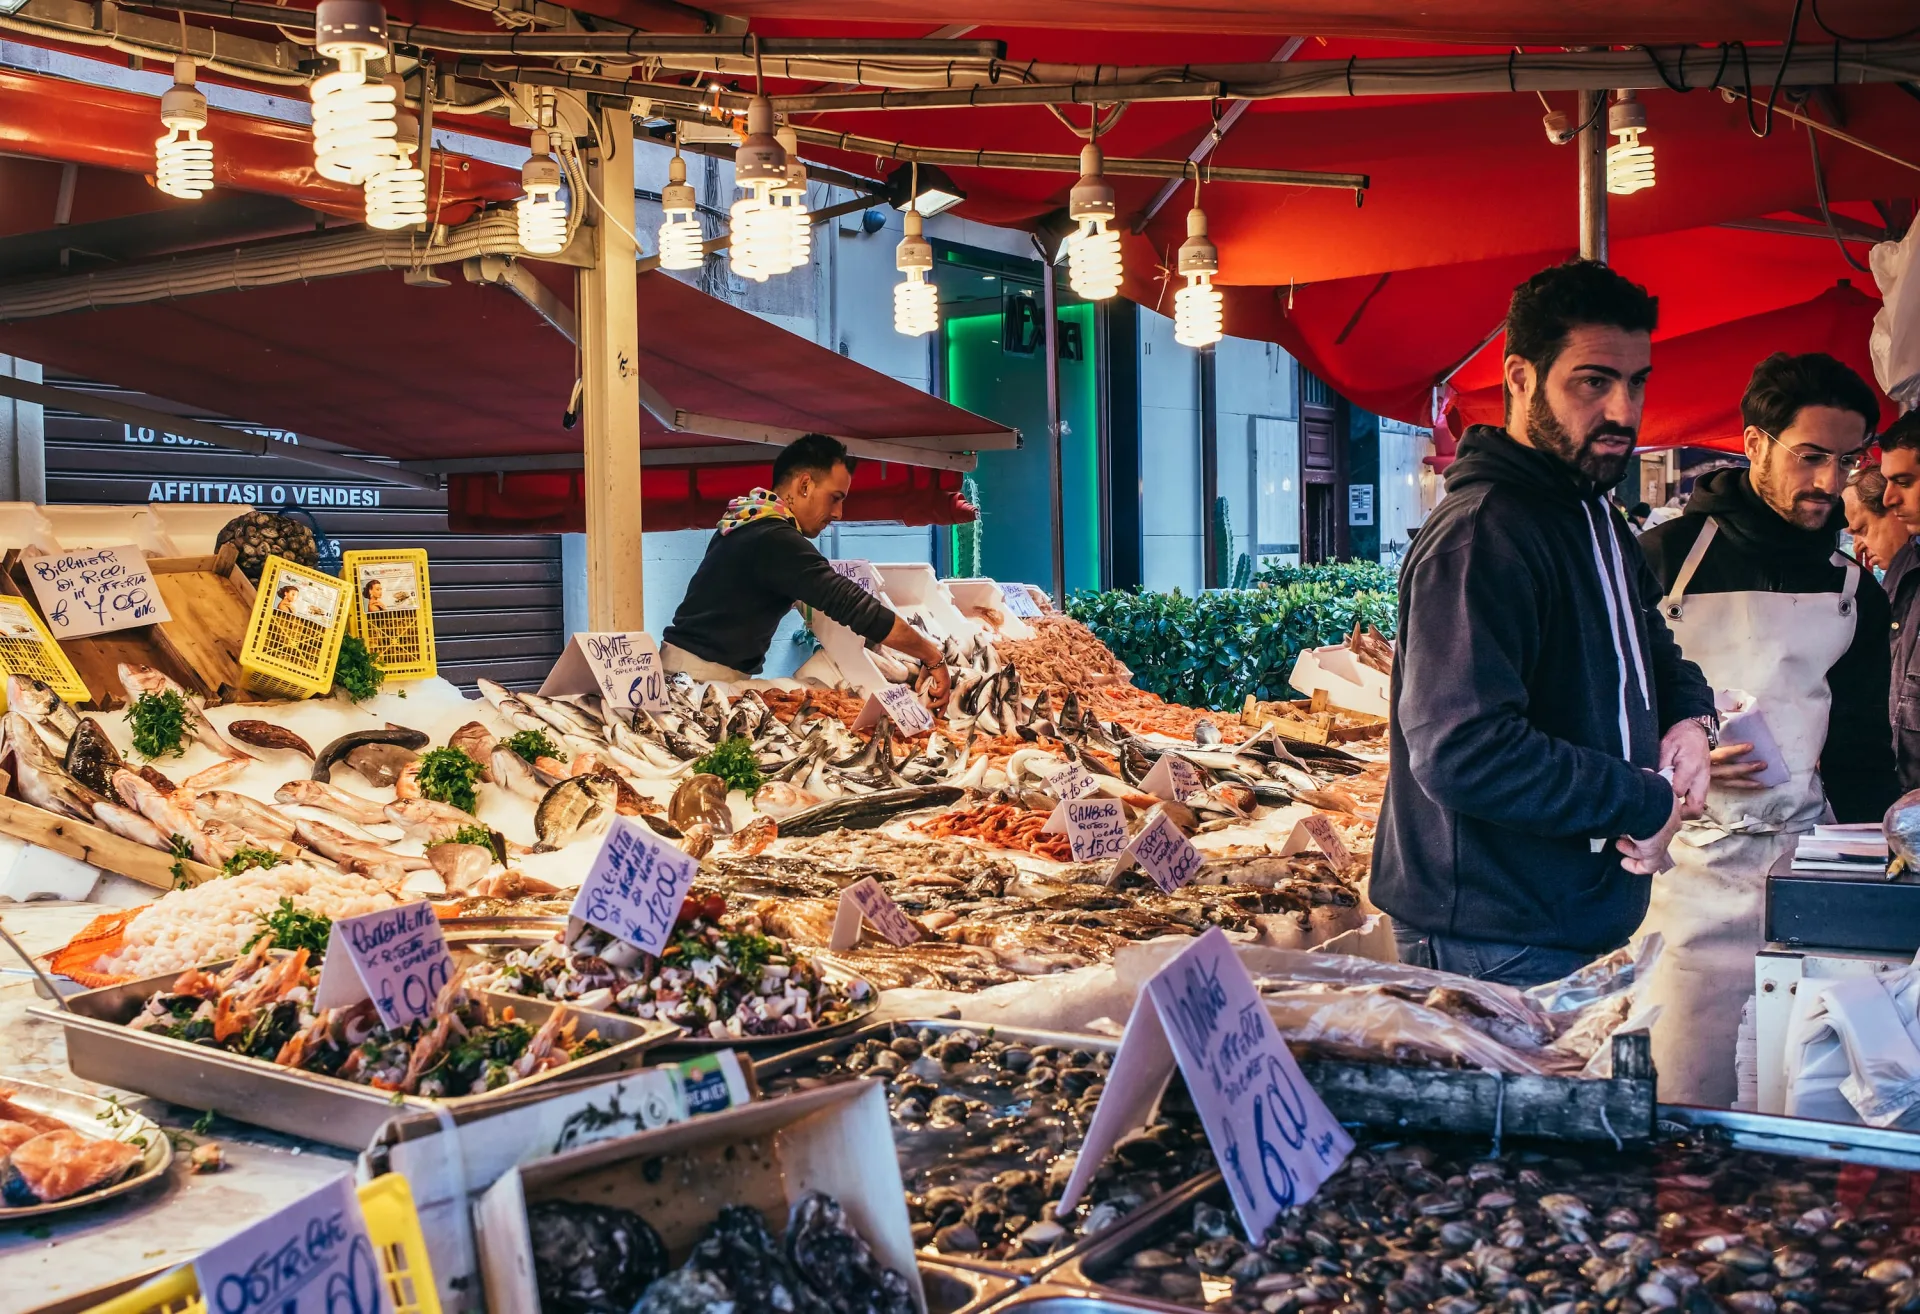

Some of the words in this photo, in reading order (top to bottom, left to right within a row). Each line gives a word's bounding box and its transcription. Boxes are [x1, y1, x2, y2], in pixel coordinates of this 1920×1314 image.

[149, 482, 263, 504] AFFITTASI
[271, 486, 286, 504] O
[292, 486, 380, 507] VENDESI
